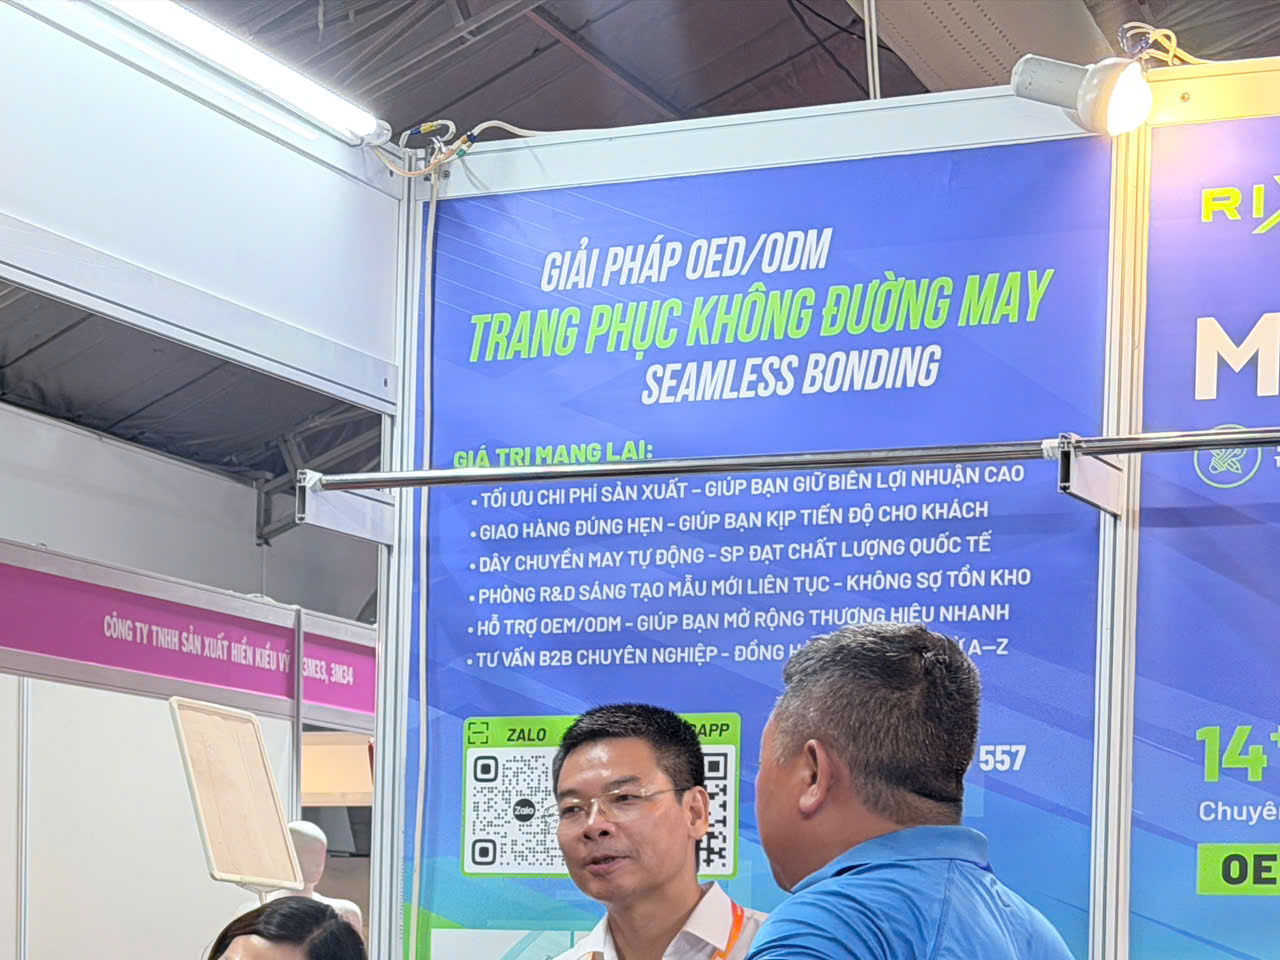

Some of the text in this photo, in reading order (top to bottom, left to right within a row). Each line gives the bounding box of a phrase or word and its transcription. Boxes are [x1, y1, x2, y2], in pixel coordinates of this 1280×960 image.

[540, 227, 833, 292] GIẢI PHÁP OED/ODM
[469, 268, 1056, 363] TRANG PHỤC KHÔNG ĐƯỜNG MAY
[641, 344, 942, 405] SEAMLESS BONDING
[453, 446, 490, 467] GIÁ
[535, 444, 601, 465] MANG
[480, 487, 507, 508] TỐI
[537, 488, 565, 506] CHI
[569, 483, 598, 504] PHÍ
[601, 481, 638, 503] SẢN
[641, 477, 688, 500] XUẤT
[705, 476, 748, 498] GIÚP
[750, 475, 789, 498] BẠN
[792, 472, 826, 492] GIỮ
[828, 470, 871, 491] BIÊN
[876, 469, 907, 492] LỢI
[911, 464, 980, 488] NHUẬN
[984, 464, 1025, 483] CAO
[479, 499, 989, 540] GIAO HÀNG ĐÚNG HẸN GIÚP BẠN KỊP TIẾN ĐỘ CHO KHÁCH
[479, 530, 992, 573] DÂY CHUYỀN MAY TỰ ĐỘNG SP ĐẠT CHẤT LƯỢNG QUỐC TẾ
[478, 583, 536, 605] PHÒNG
[540, 585, 576, 603] R&D
[579, 580, 626, 601] SÁNG
[630, 582, 664, 603] TẠO
[668, 574, 708, 597] MẪU
[711, 576, 743, 597] MỚI
[747, 574, 789, 596] LIÊN
[793, 575, 830, 597] TỤC
[846, 569, 912, 591] KHÔNG
[916, 568, 943, 593] SỢ
[990, 567, 1031, 586] KHO
[104, 611, 133, 641] CÔNG
[135, 622, 149, 645] TY
[151, 625, 179, 651] TNHH
[476, 613, 501, 637] HỖ
[504, 617, 538, 639] TRỢ
[540, 615, 622, 635] OEM/ODM
[636, 611, 679, 632] GIÚP
[682, 613, 719, 634] BẠN
[724, 607, 750, 629] MỞ
[754, 608, 805, 631] RỘNG
[808, 606, 886, 626] THƯƠNG
[939, 603, 1010, 622] NHANH
[476, 651, 501, 668] TƯ
[501, 646, 536, 667] VẤN
[540, 649, 572, 666] B2B
[576, 644, 648, 666] CHUYÊN
[652, 643, 718, 667] NGHIỆP
[734, 640, 784, 661] ĐỒNG
[330, 663, 354, 686] 3M34
[506, 728, 547, 742] ZALO
[979, 744, 1027, 772] 557
[514, 805, 534, 816] Zalo
[1199, 800, 1280, 826] Chuyê
[1221, 854, 1277, 885] OE
